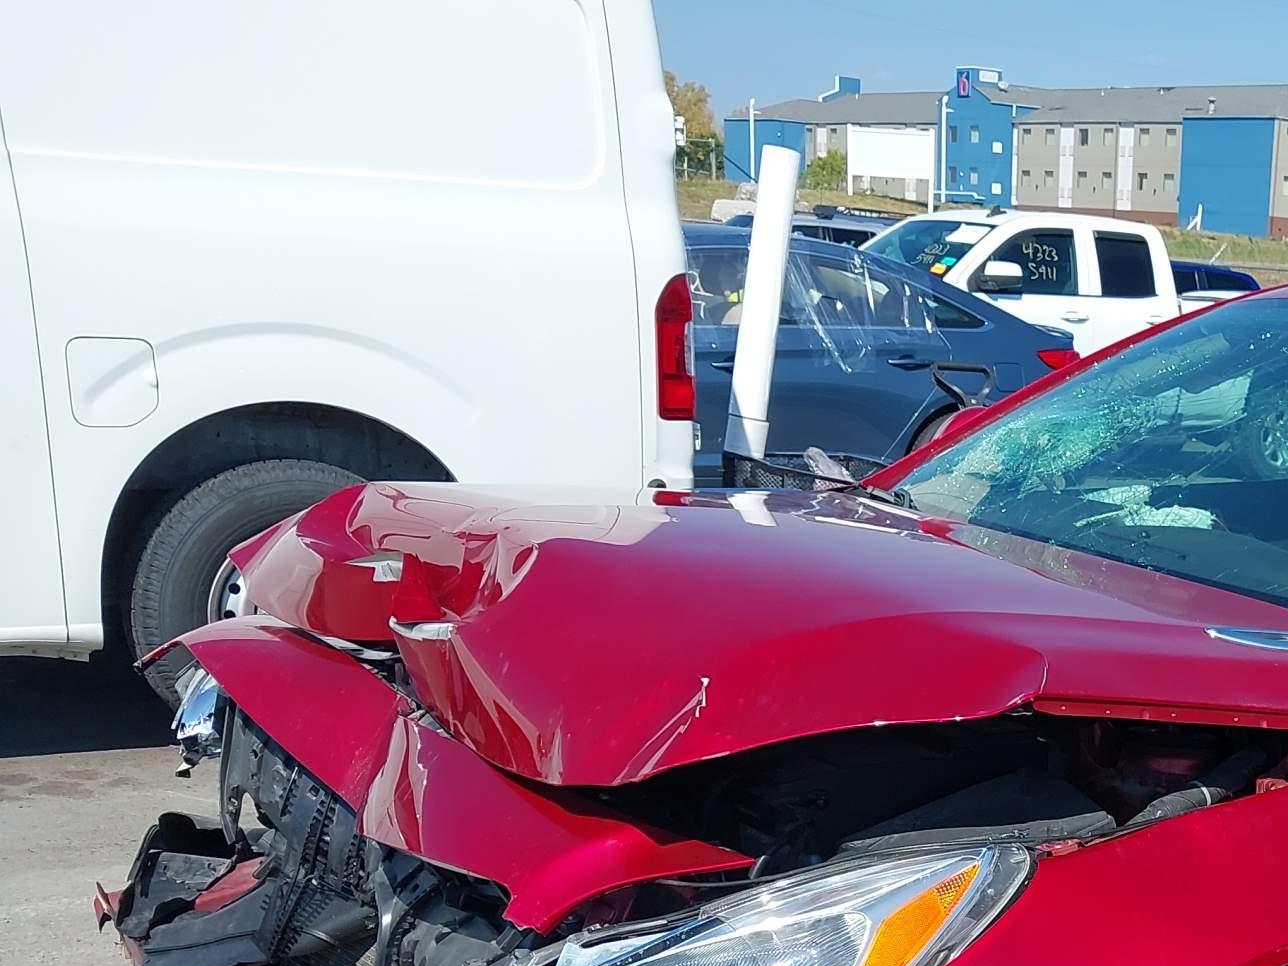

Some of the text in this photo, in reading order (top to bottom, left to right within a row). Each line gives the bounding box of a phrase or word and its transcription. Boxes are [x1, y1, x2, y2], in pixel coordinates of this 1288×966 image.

[960, 71, 969, 96] 6
[1022, 242, 1059, 261] 4323
[1028, 263, 1057, 280] 5911
